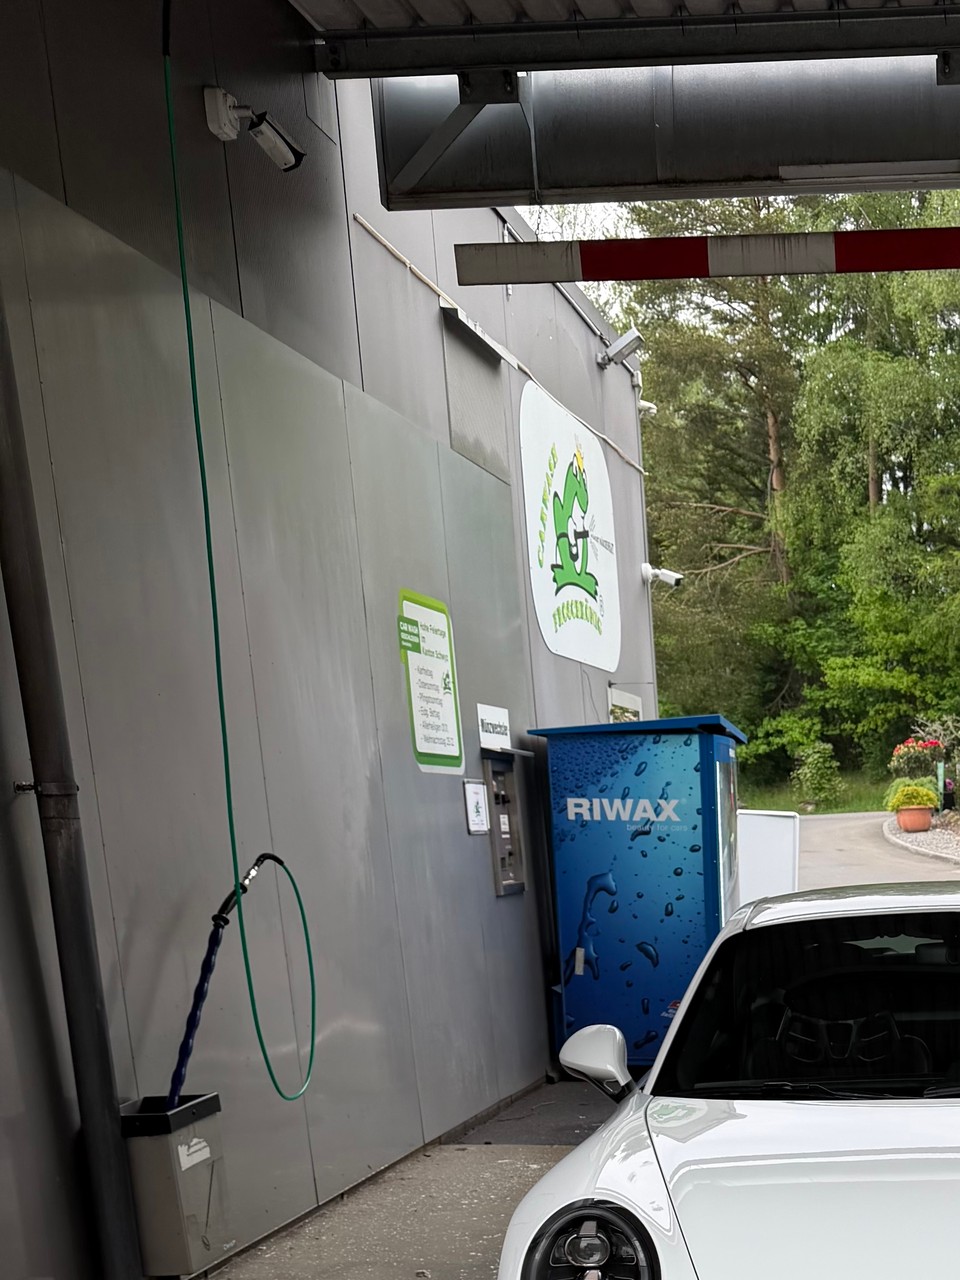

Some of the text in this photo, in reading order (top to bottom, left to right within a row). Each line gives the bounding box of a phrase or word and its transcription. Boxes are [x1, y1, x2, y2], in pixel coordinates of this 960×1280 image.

[567, 797, 681, 822] RIWAX
[656, 823, 667, 832] for
[670, 824, 688, 832] cars
